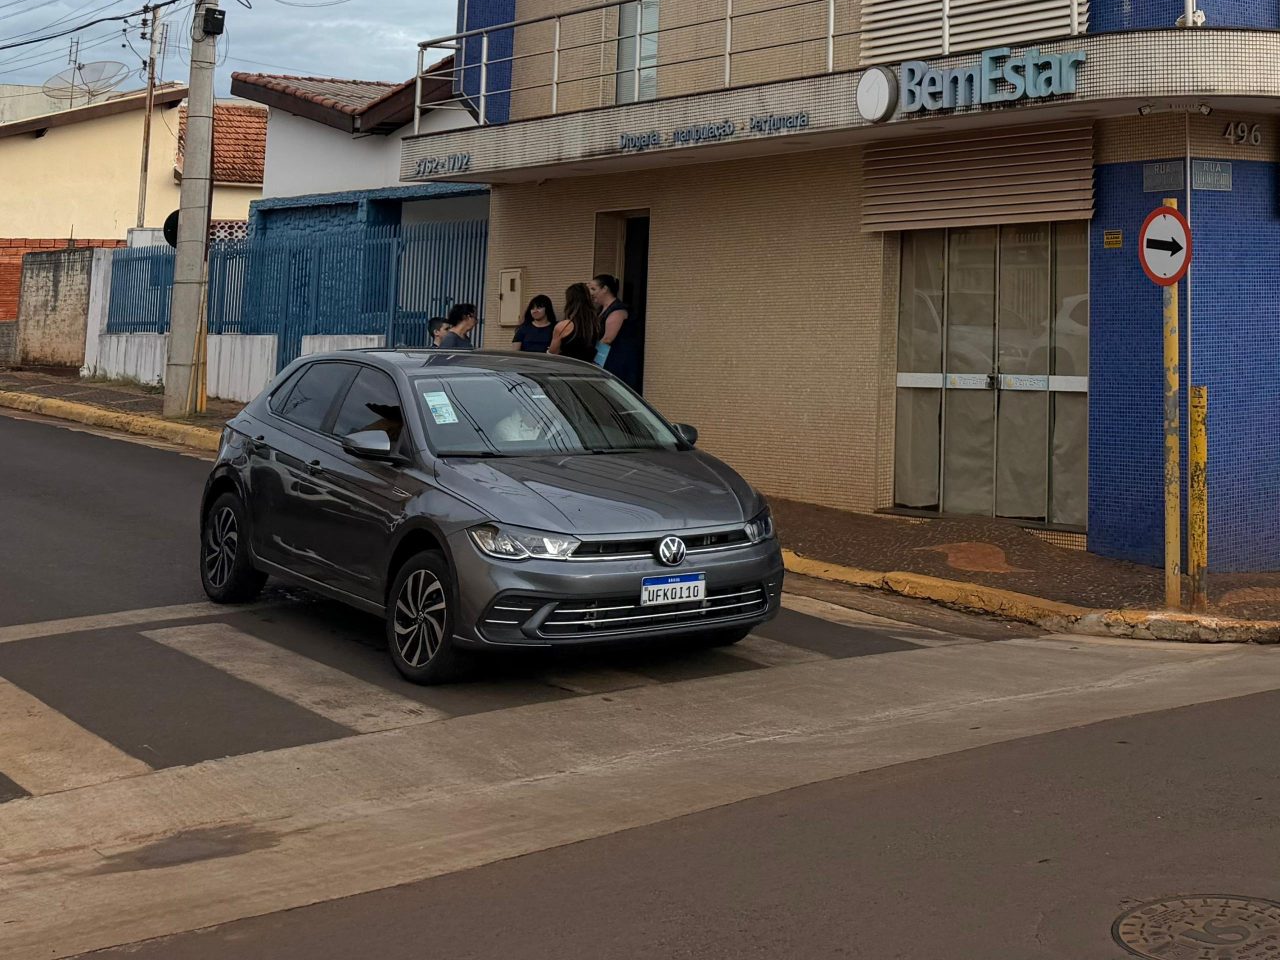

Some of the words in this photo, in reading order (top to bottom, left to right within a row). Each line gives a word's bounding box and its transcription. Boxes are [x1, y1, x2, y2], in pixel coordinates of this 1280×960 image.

[900, 47, 1086, 113] BemEstar
[620, 131, 660, 150] Drogaria
[750, 112, 809, 132] Perfumaria
[1223, 121, 1261, 146] 496
[1154, 164, 1171, 174] RUA
[1203, 163, 1222, 172] RUA
